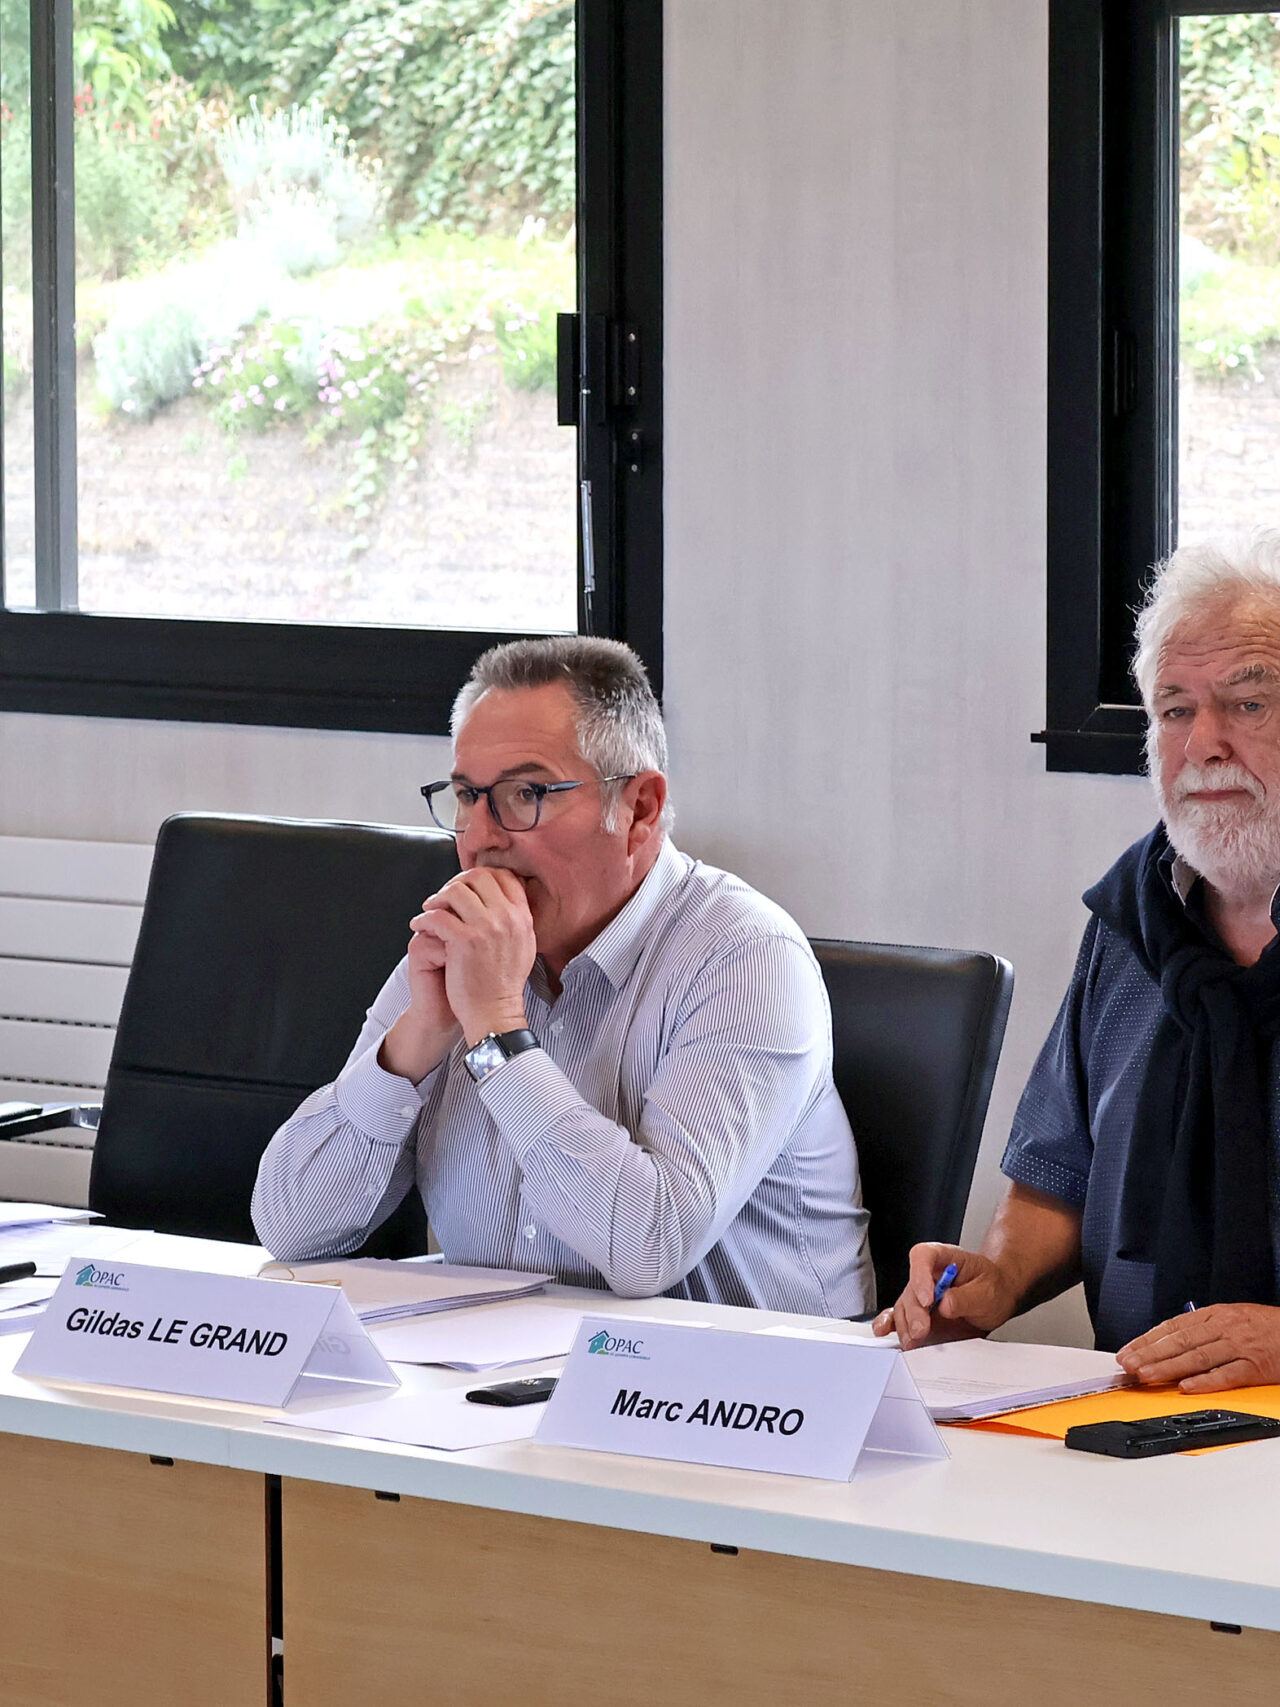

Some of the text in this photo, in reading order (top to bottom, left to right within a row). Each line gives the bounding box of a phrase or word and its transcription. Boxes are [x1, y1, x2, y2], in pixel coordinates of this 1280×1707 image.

[90, 1270, 125, 1286] OPAC
[66, 1307, 145, 1339] Gildas
[147, 1317, 189, 1344] LE
[189, 1322, 288, 1357] GRAND
[604, 1337, 644, 1354] OPAC
[610, 1389, 805, 1436] Marc ANDRO
